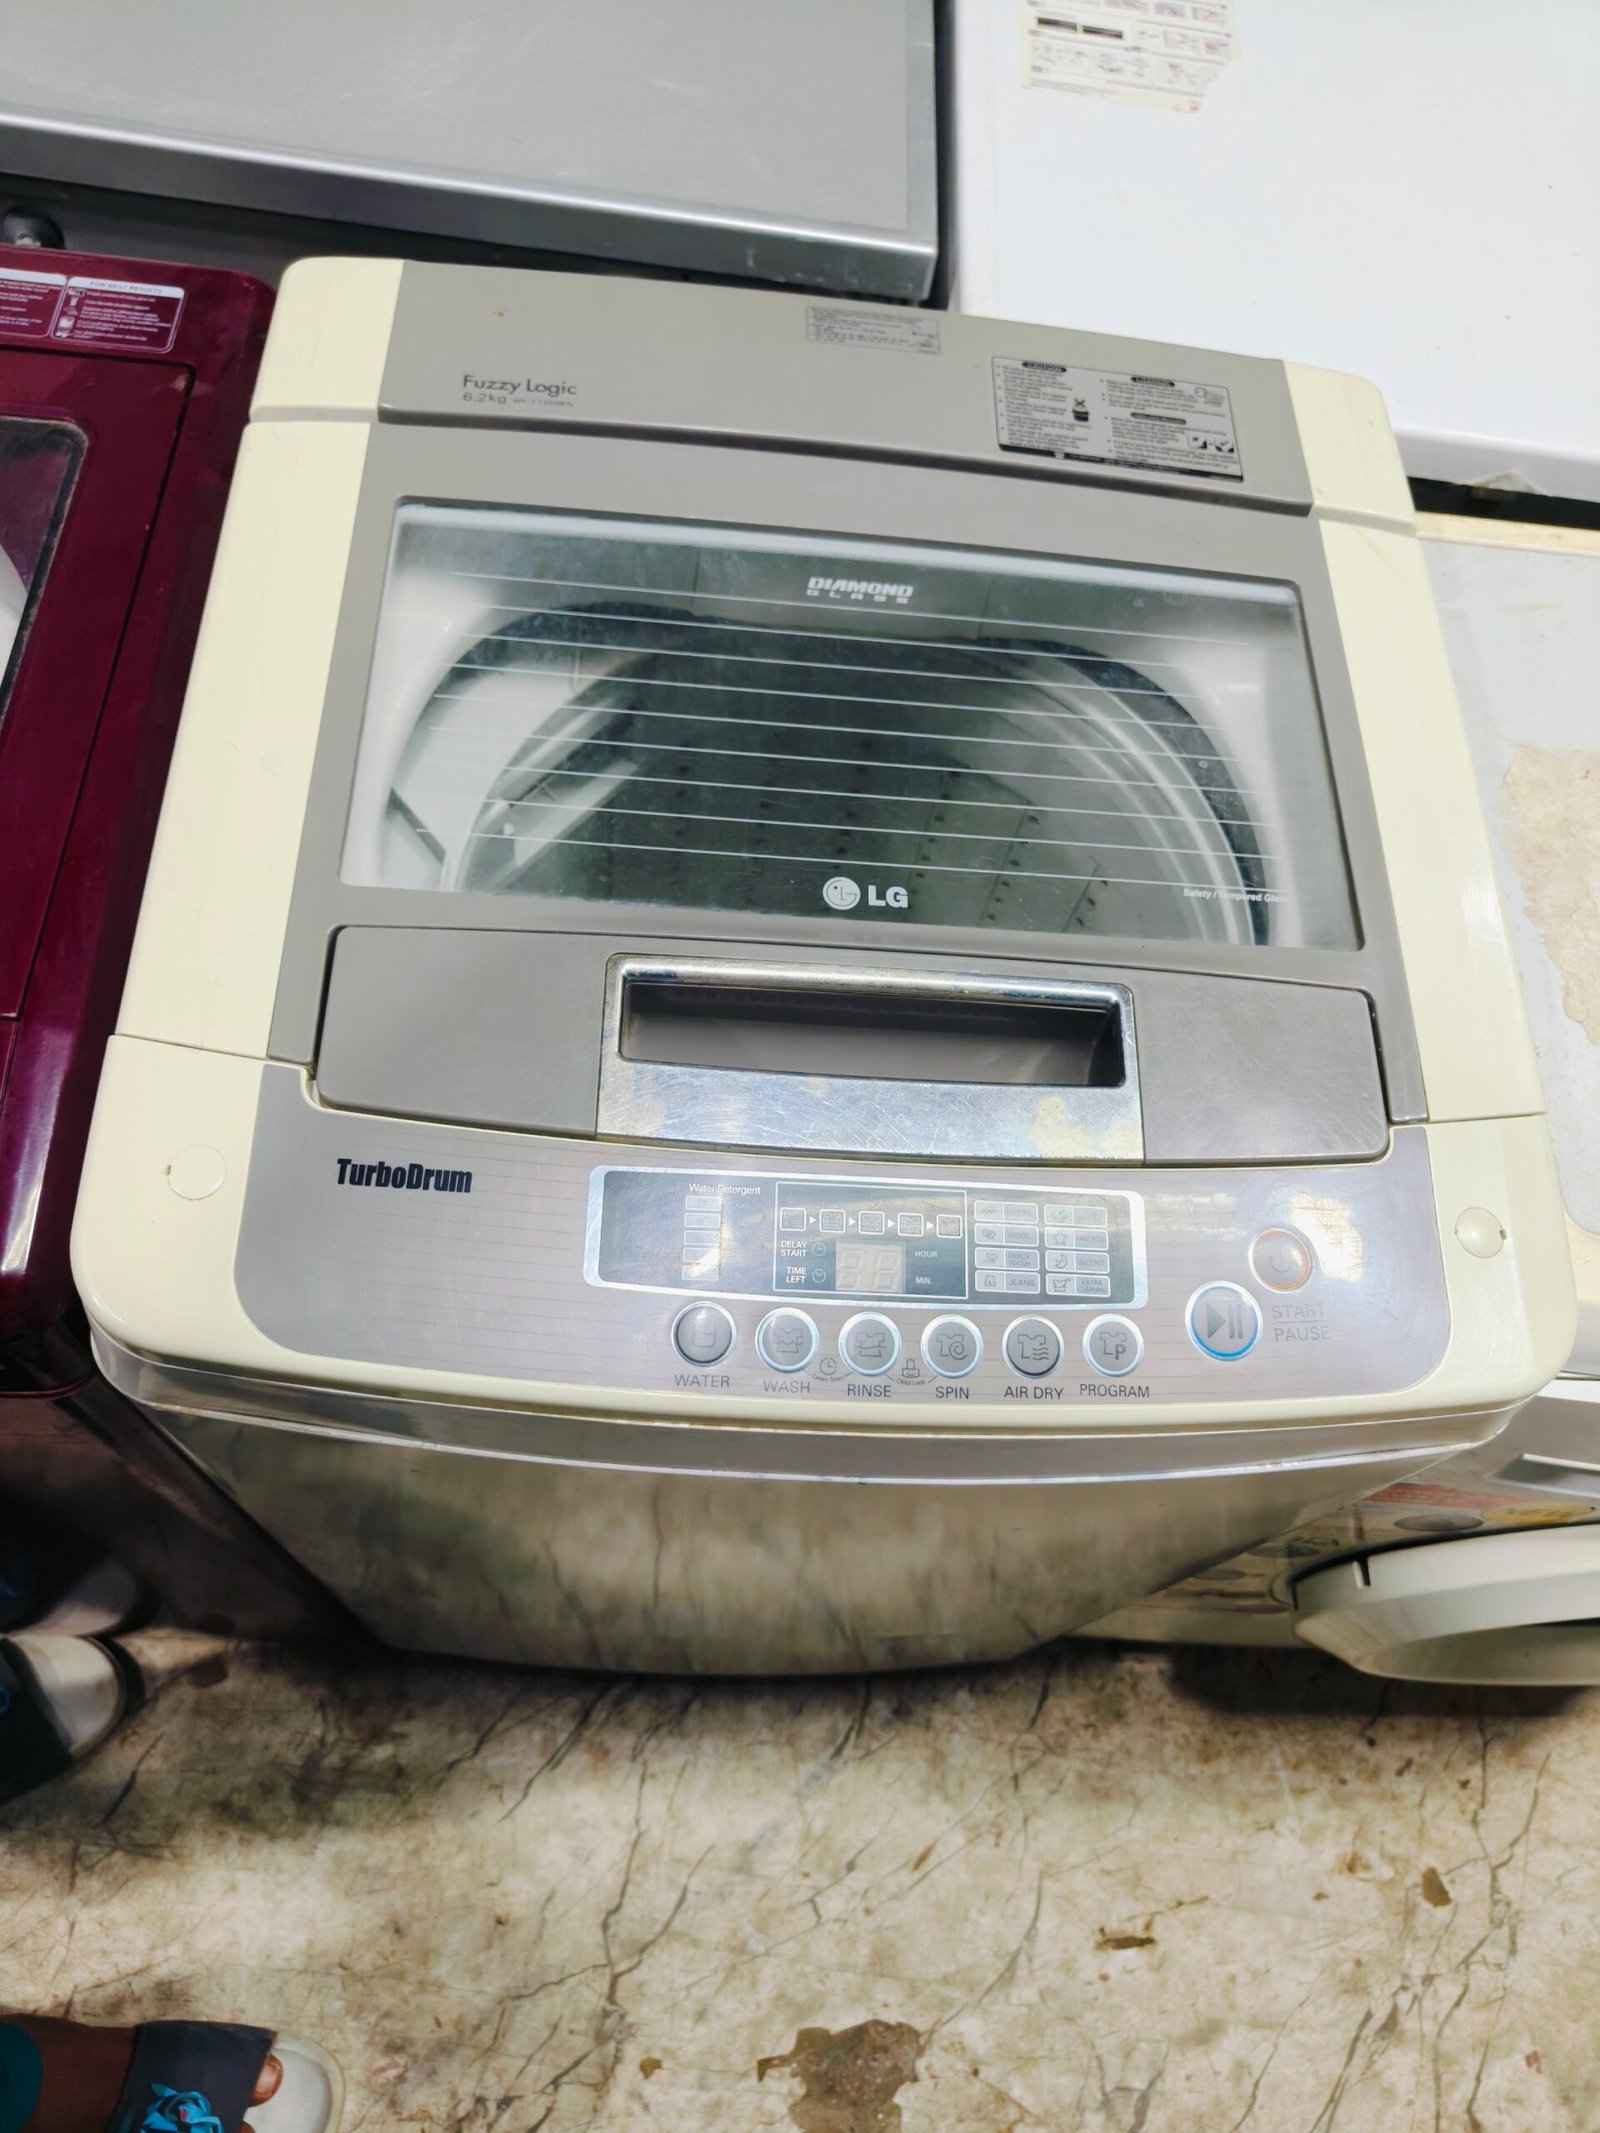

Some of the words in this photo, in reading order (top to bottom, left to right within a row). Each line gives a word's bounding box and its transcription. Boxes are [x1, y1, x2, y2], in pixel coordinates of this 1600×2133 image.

[463, 374, 521, 394] Fuzzy
[526, 379, 577, 397] Logic
[463, 392, 507, 404] 6.2kg
[807, 576, 914, 597] DIAMOND
[867, 884, 909, 909] LG
[1183, 888, 1212, 900] Safety
[337, 1158, 473, 1193] TurboDrum
[780, 1240, 808, 1249] DELAY
[780, 1248, 807, 1257] START
[914, 1250, 938, 1258] HOUR
[1078, 1258, 1105, 1267] SILENT
[786, 1266, 807, 1275] TIME
[785, 1275, 806, 1284] LEFT
[915, 1276, 933, 1285] MIN.
[1007, 1278, 1035, 1287] JEANS
[1271, 1303, 1327, 1319] START
[1274, 1326, 1331, 1342] PAUSE
[674, 1374, 730, 1388] WATER
[763, 1379, 811, 1394] WASH
[847, 1384, 892, 1398] RINSE
[935, 1386, 969, 1399] SPIN
[1004, 1385, 1028, 1398] AIR
[1033, 1387, 1064, 1400] DRY
[1080, 1383, 1150, 1398] PROGRAM
